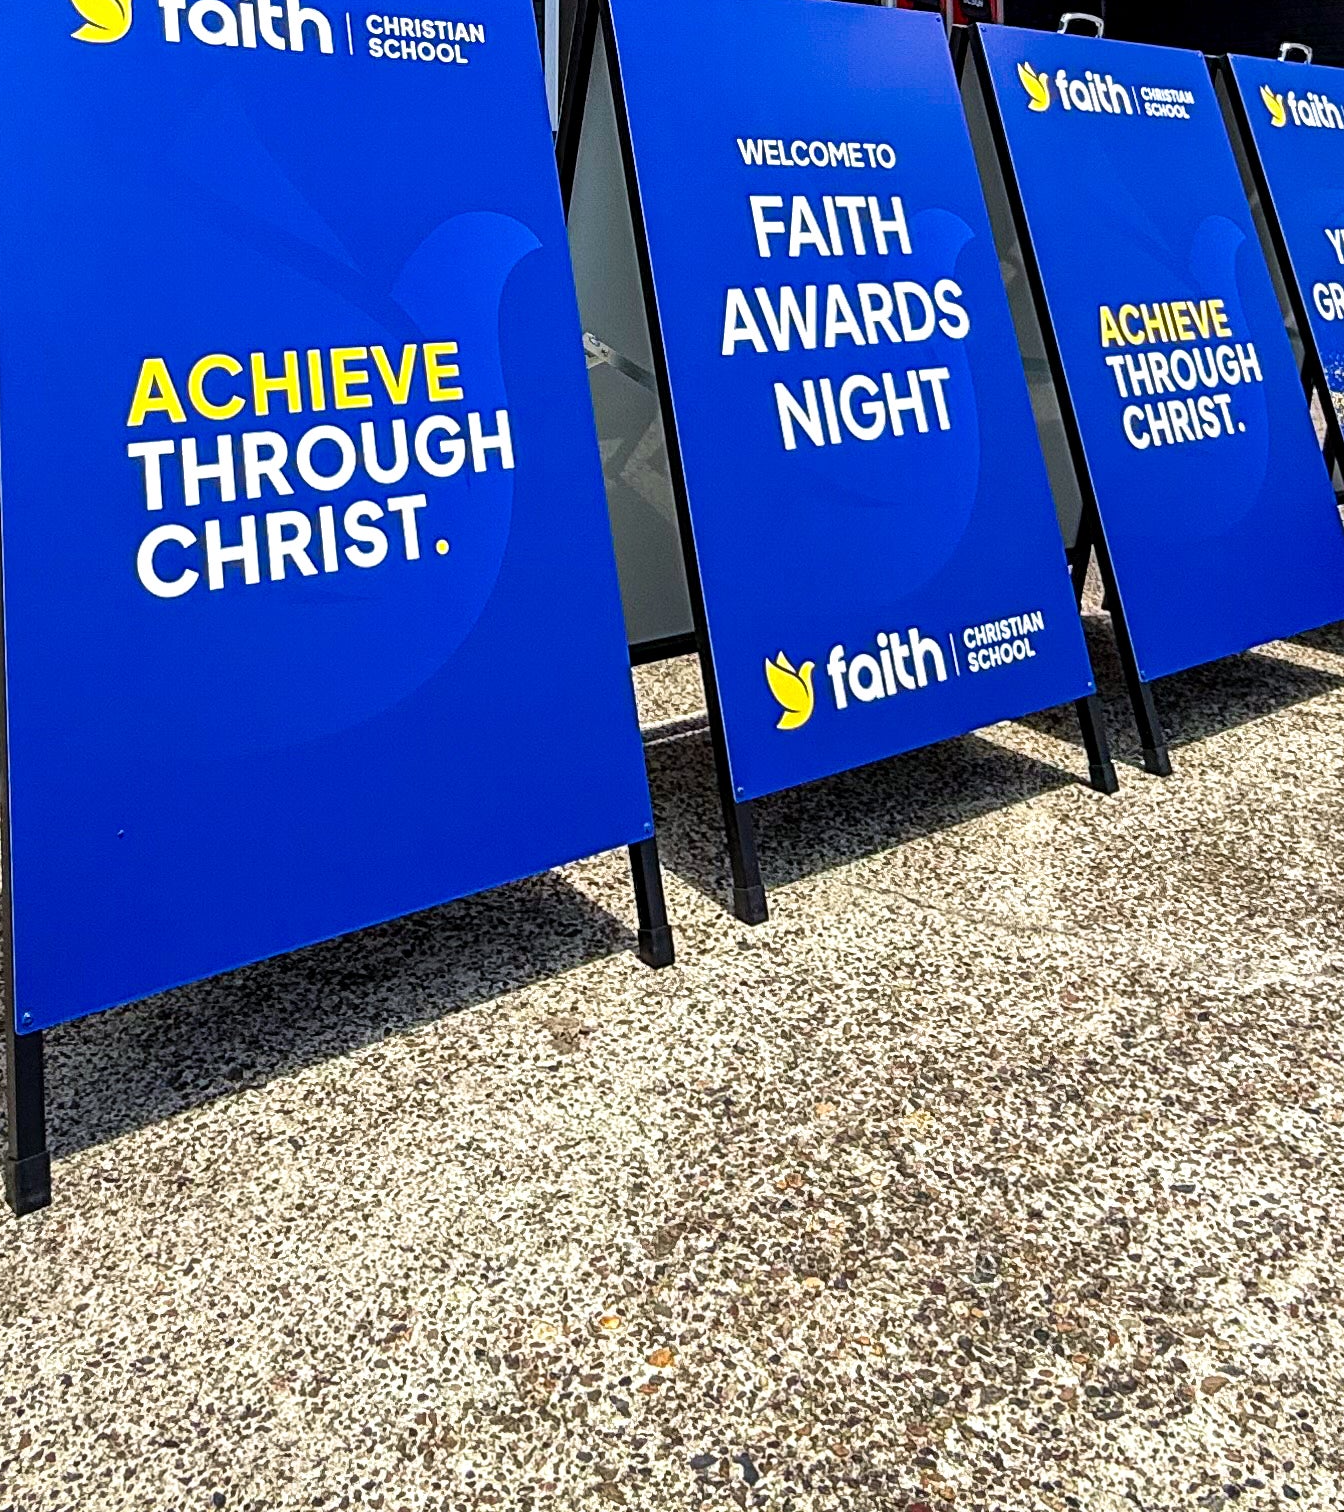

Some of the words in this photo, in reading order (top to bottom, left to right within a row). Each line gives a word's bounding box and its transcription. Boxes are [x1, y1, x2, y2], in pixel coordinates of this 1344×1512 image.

[366, 14, 485, 44] CHRISTIAN
[368, 38, 468, 64] SCHOOL
[1055, 69, 1133, 115] faith
[1140, 87, 1195, 105] CHRISTIAN
[1145, 104, 1190, 120] SCHOOL
[1288, 89, 1344, 130] faith
[737, 138, 865, 167] WELCOME
[863, 143, 896, 168] TO
[749, 195, 912, 257] FAITH
[721, 279, 970, 356] AWARDS
[1099, 299, 1233, 347] ACHIEVE
[126, 341, 464, 427] ACHIEVE
[1105, 342, 1263, 398] THROUGH
[773, 366, 951, 450] NIGHT
[1123, 394, 1246, 450] CHRIST.
[127, 409, 515, 511] THROUGH
[136, 493, 450, 598] CHRIST.
[963, 611, 1044, 649] CHRISTIAN
[827, 628, 948, 710] faith
[967, 638, 1036, 673] SCHOOL
